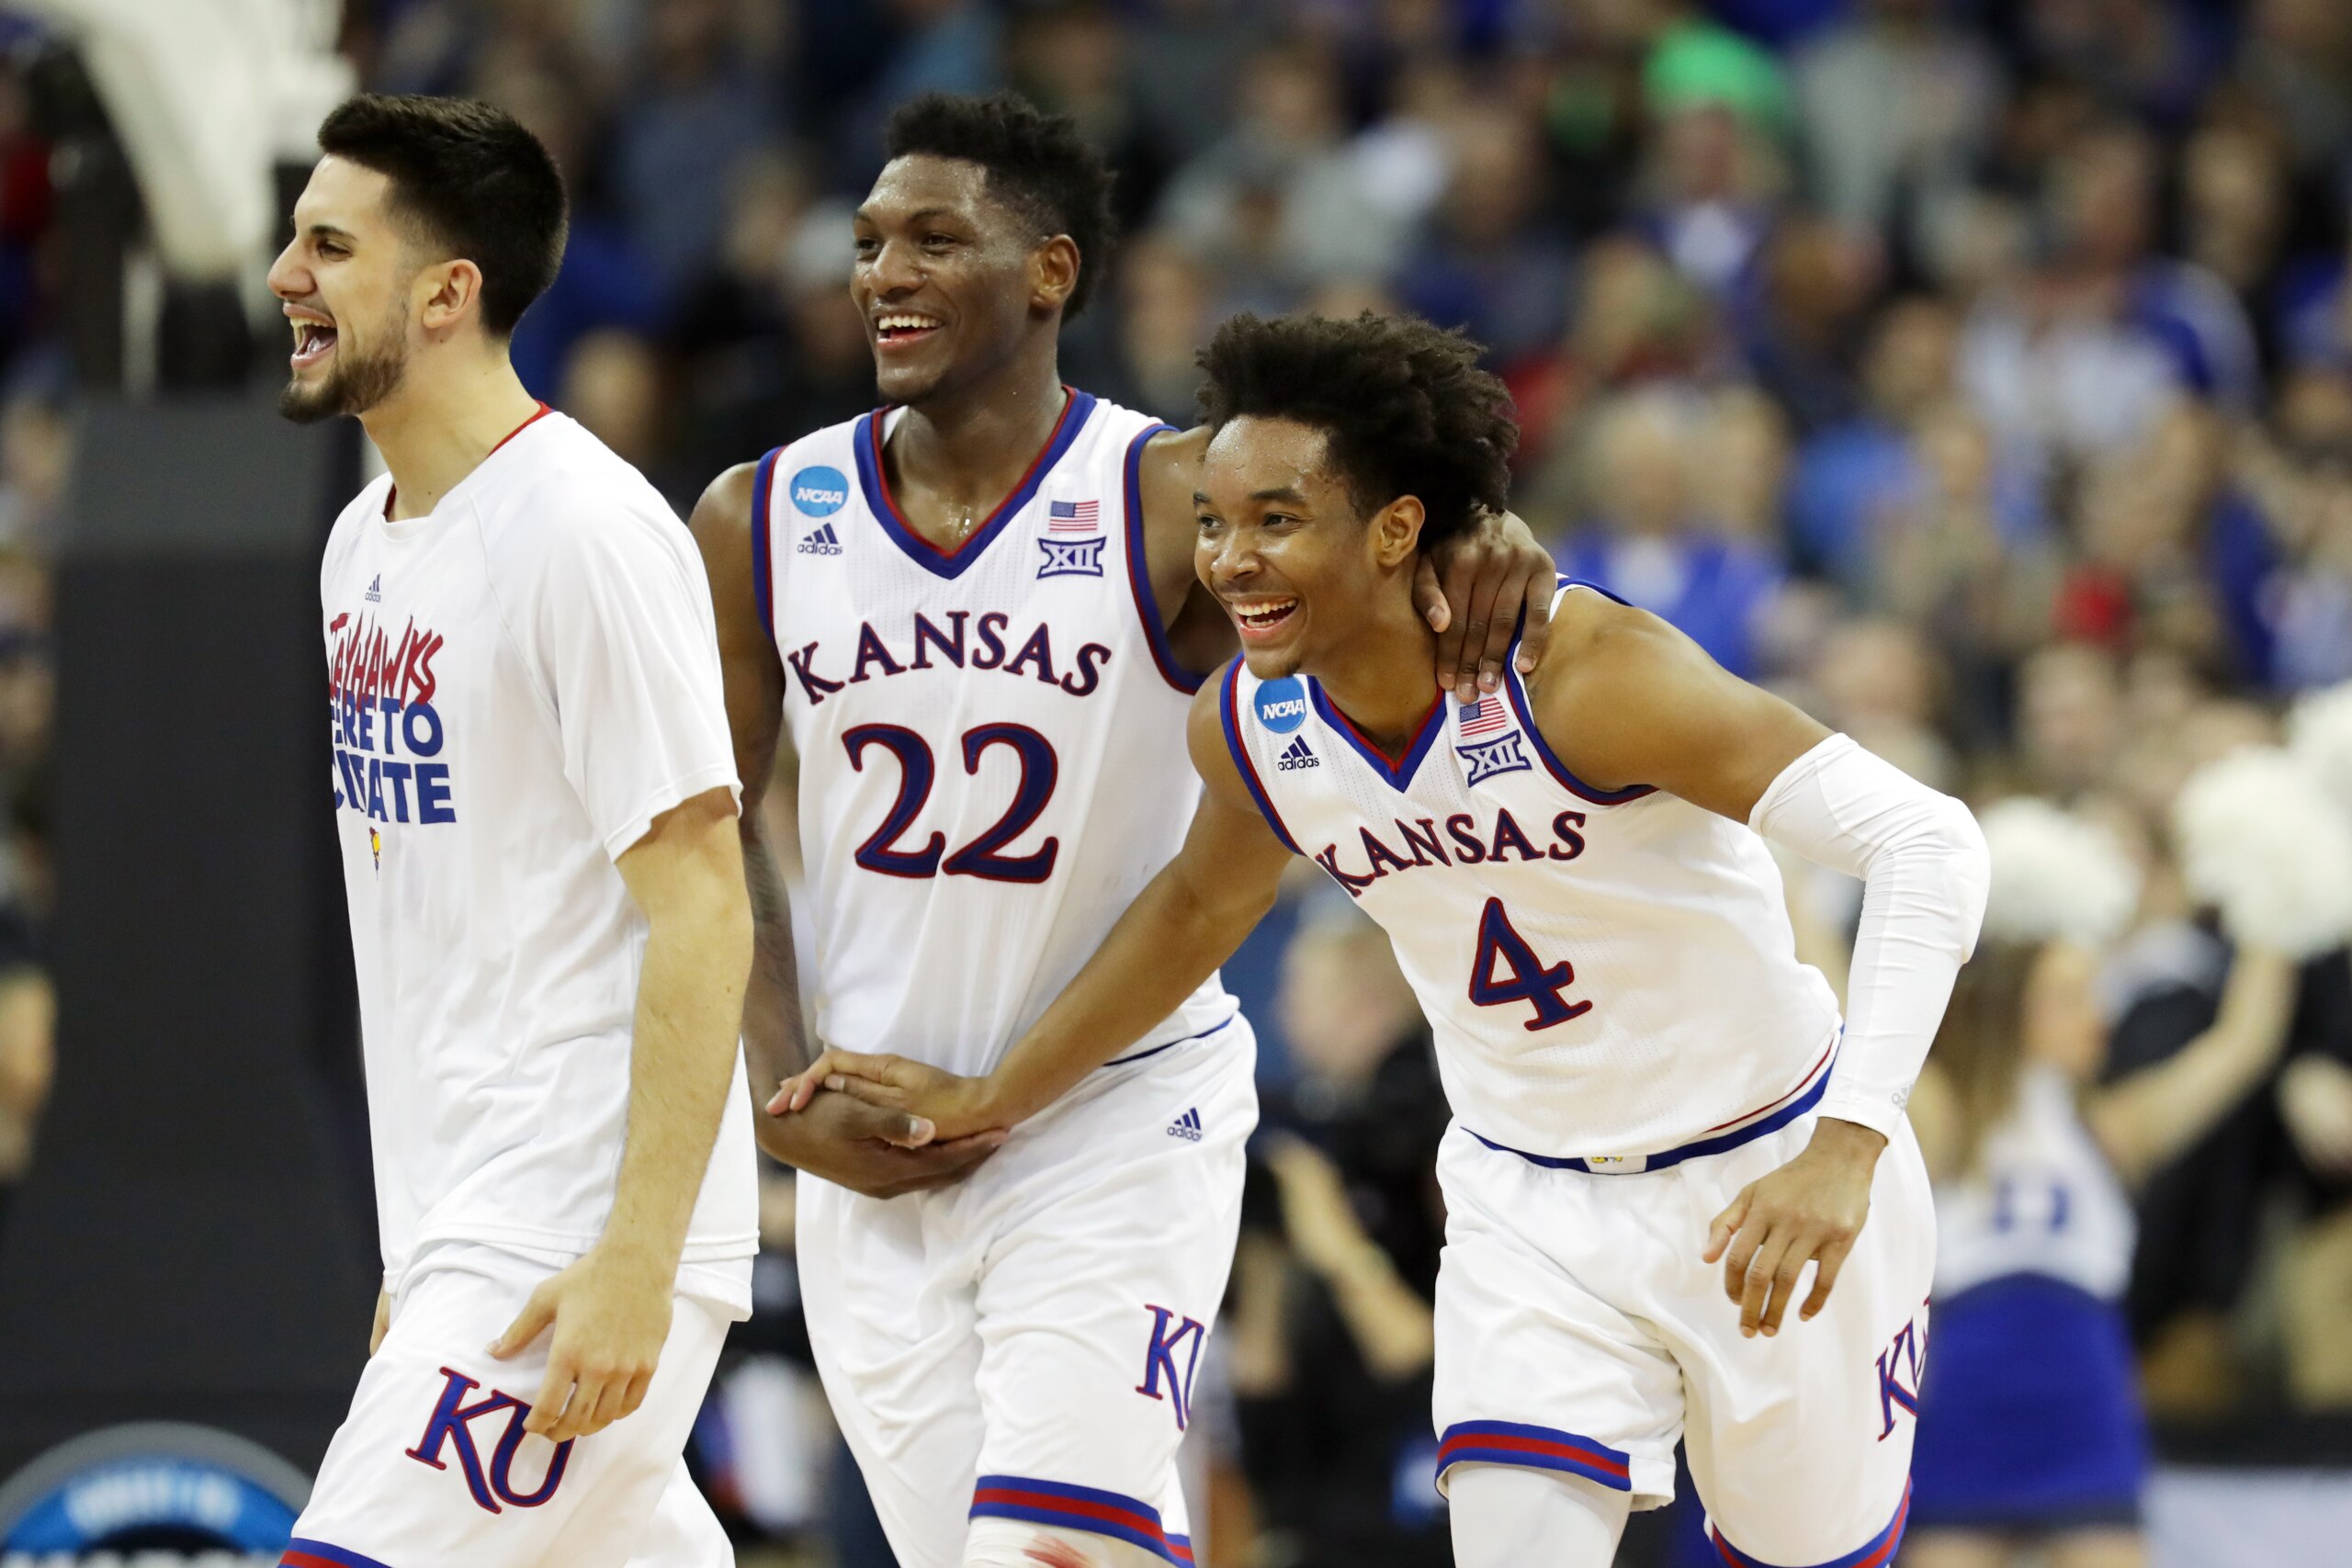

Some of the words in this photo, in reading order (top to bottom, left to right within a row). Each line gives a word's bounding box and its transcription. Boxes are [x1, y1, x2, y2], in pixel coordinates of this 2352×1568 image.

[796, 487, 843, 504] NCAA
[797, 543, 842, 556] adidas
[1036, 536, 1106, 580] XII
[787, 611, 1112, 705] KANSAS
[331, 686, 375, 752] ERE
[380, 696, 444, 758] TO
[1262, 698, 1305, 720] NCAA
[1277, 755, 1320, 771] adidas
[1454, 728, 1532, 788] XII
[841, 722, 1058, 884] 22
[1315, 807, 1586, 897] KANSAS
[1468, 897, 1593, 1032] 4
[405, 1366, 576, 1515] KU
